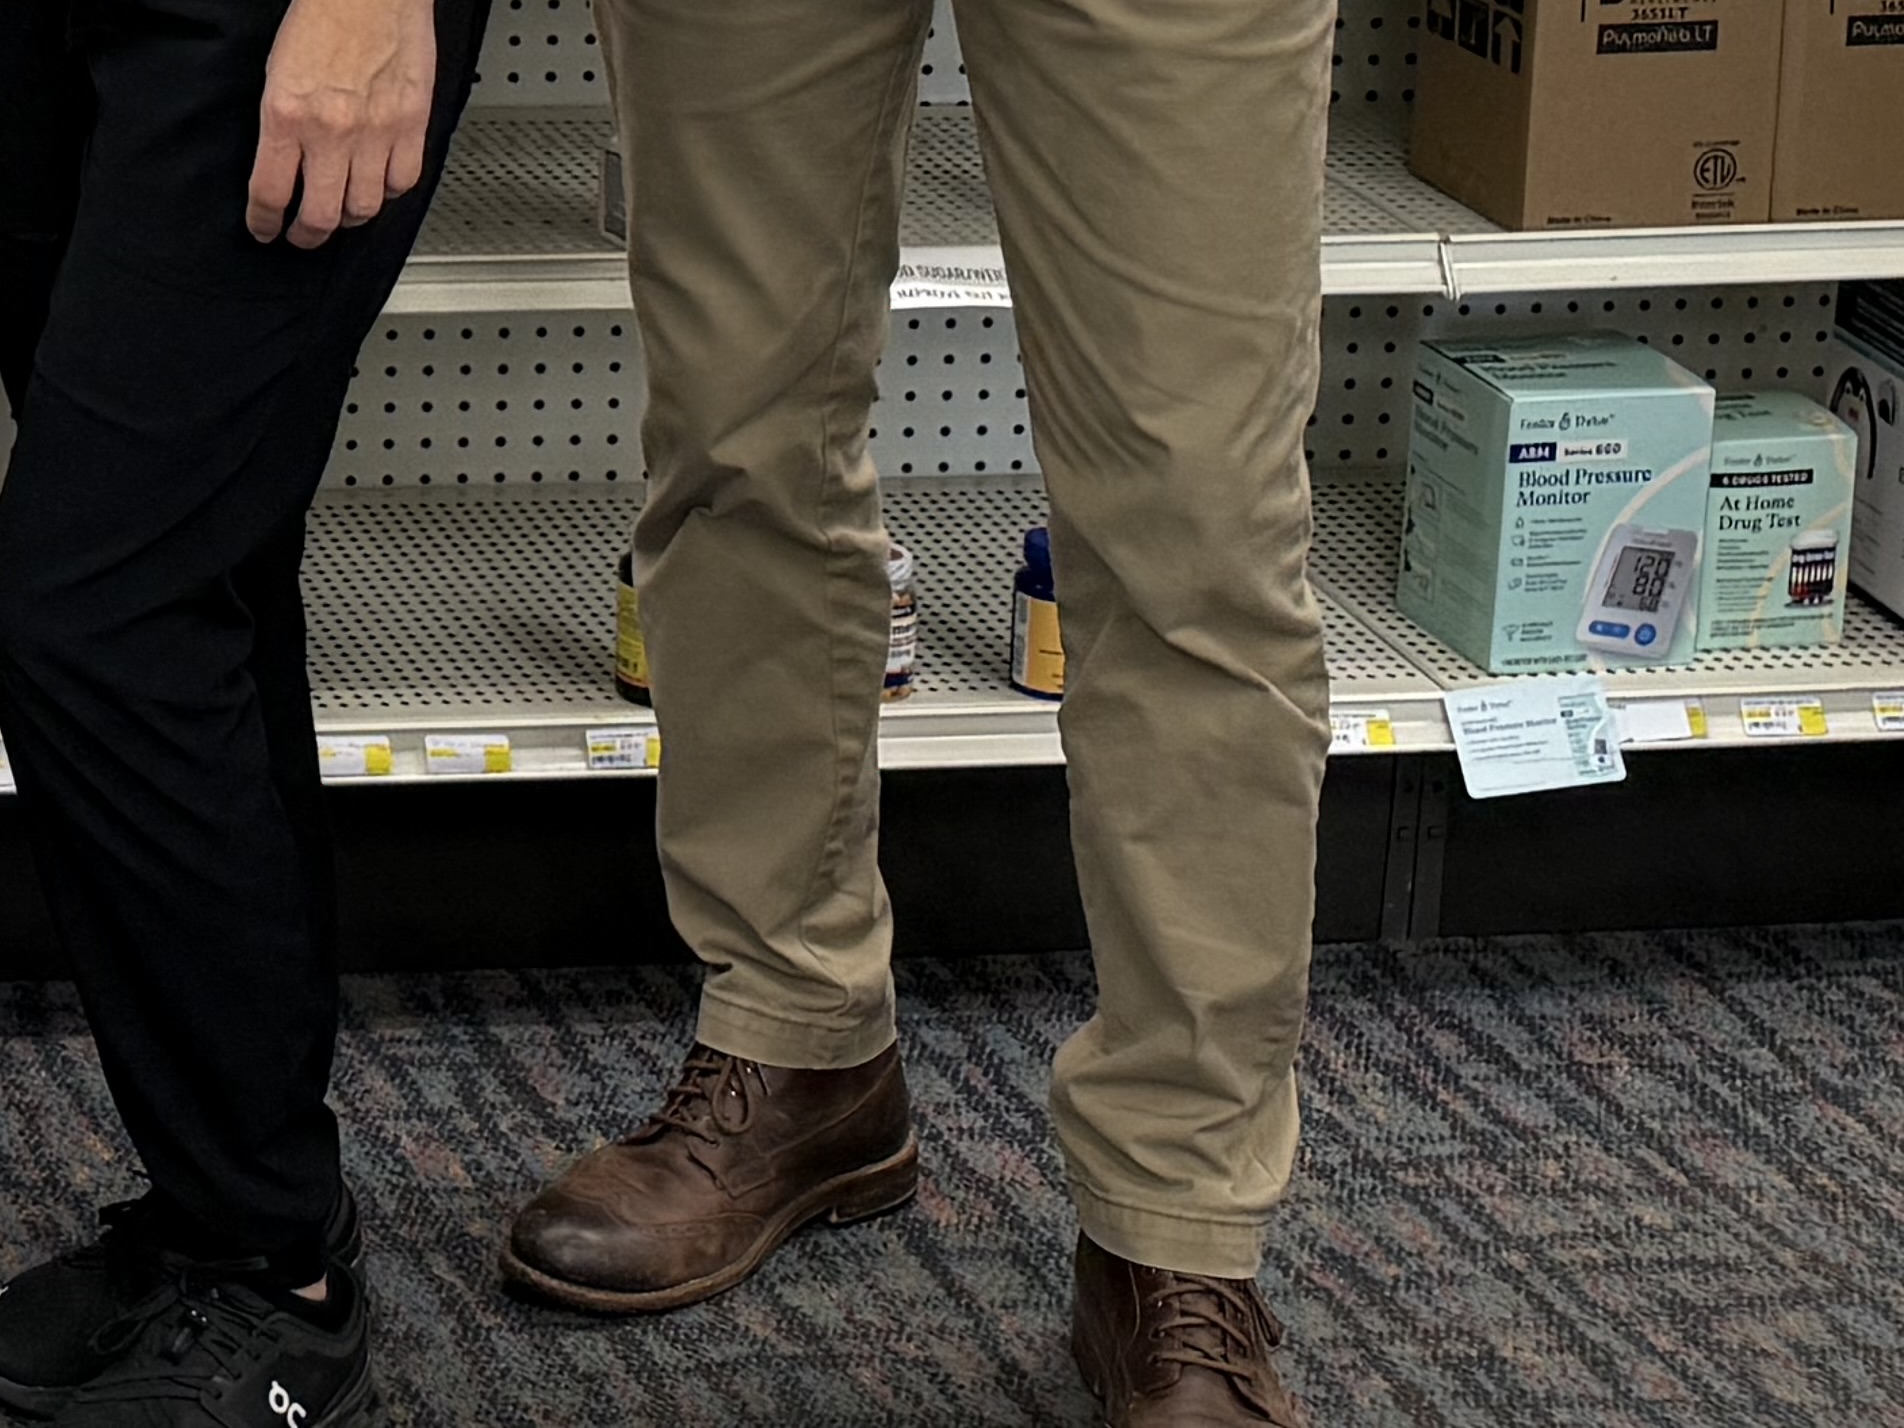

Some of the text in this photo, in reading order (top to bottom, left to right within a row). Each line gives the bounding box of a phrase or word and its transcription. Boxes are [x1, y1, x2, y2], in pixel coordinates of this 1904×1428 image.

[1519, 468, 1652, 488] Blood Pressure
[1516, 490, 1591, 507] Monitor
[1719, 495, 1795, 511] At Home
[1719, 513, 1801, 532] Drug Test
[1634, 555, 1672, 578] 120
[1632, 571, 1666, 597] 80
